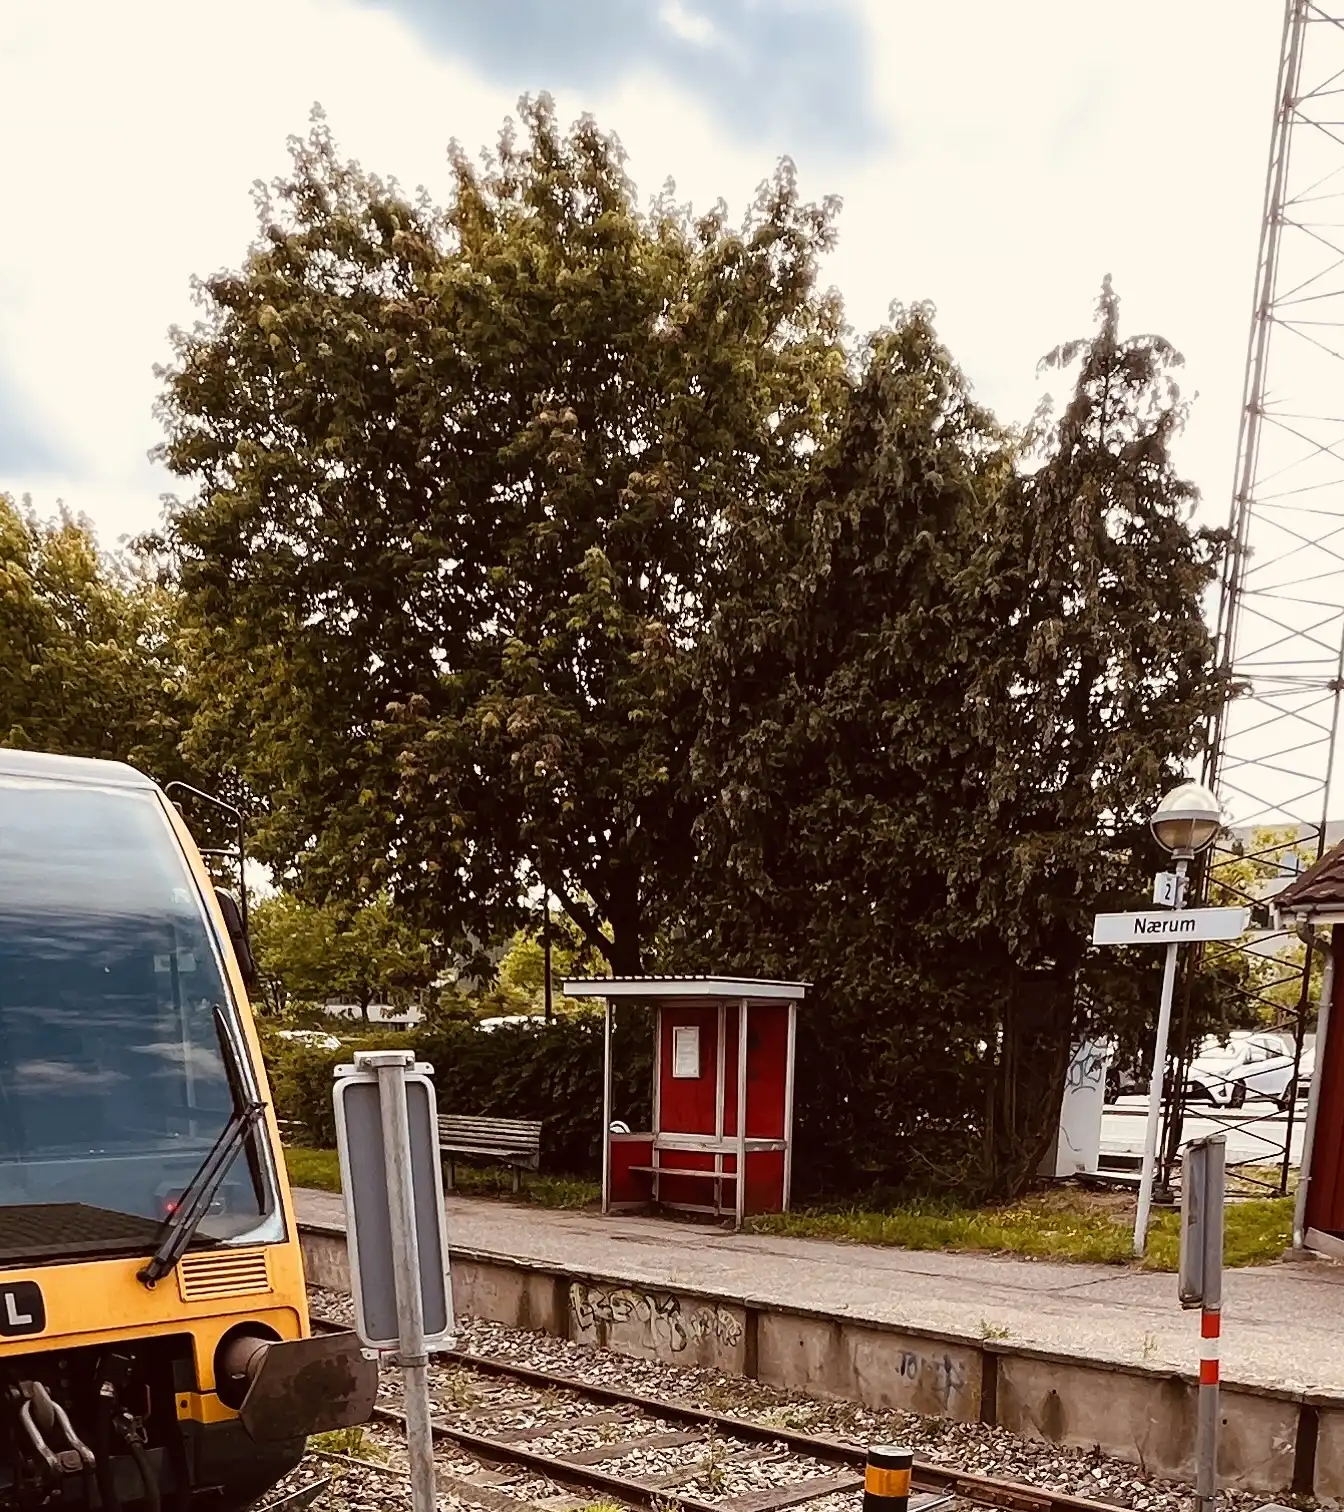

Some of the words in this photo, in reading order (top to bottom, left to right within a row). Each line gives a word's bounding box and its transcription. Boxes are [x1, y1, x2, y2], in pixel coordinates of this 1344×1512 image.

[1163, 883, 1172, 901] 2
[1133, 918, 1196, 935] Nærum
[4, 1292, 33, 1326] L
